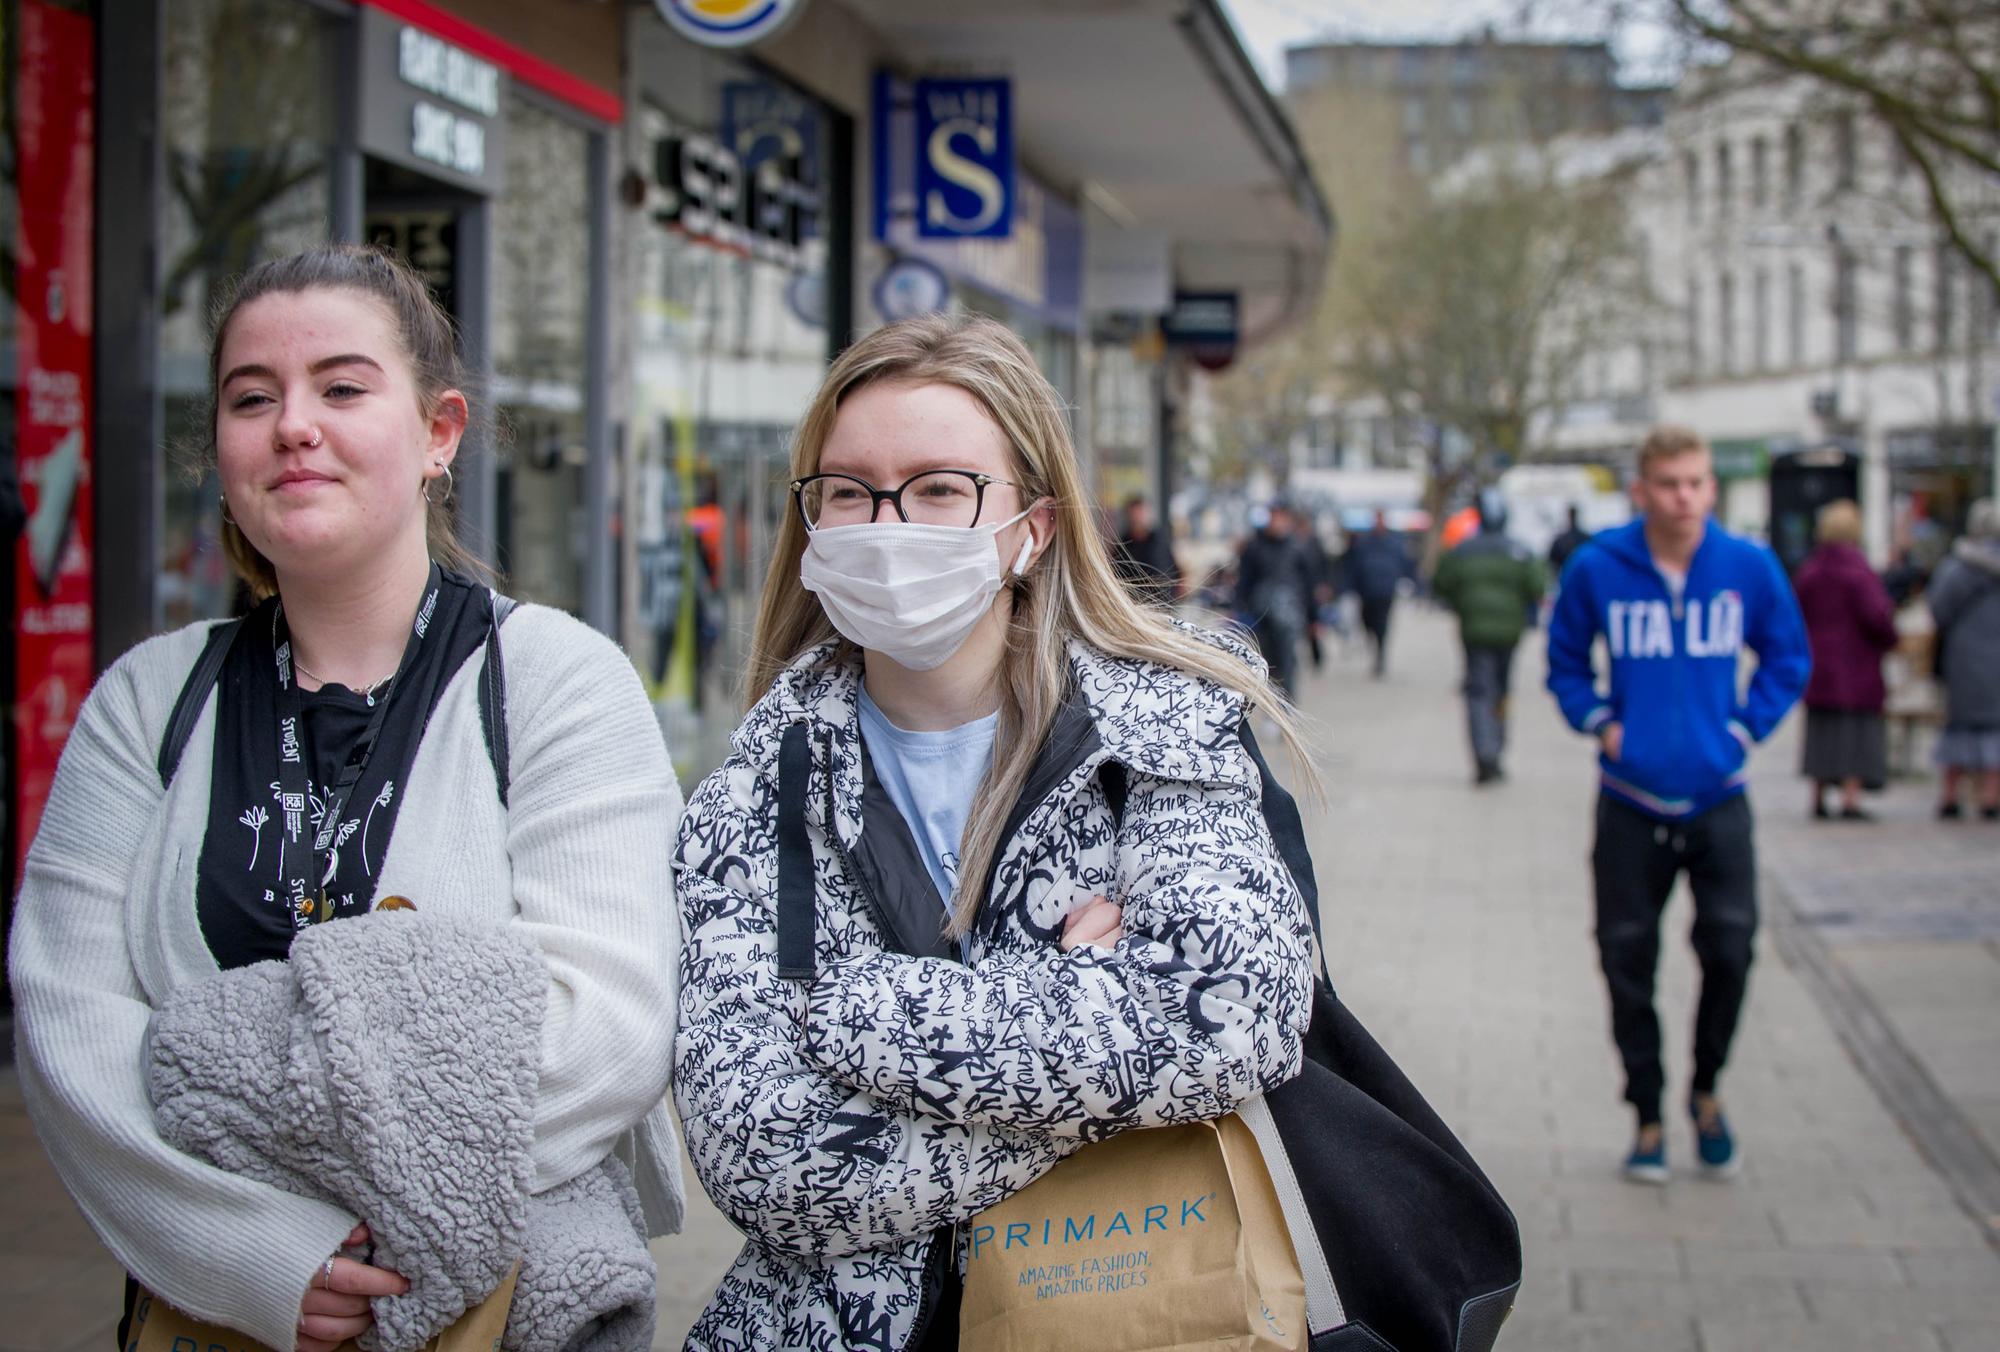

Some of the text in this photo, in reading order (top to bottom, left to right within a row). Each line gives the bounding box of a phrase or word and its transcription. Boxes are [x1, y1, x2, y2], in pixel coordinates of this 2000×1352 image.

[926, 117, 1006, 234] S
[282, 717, 300, 763] STUDENT
[973, 1196, 1207, 1260] PRIMARK
[1018, 1250, 1153, 1287] AMAZING FASHION,
[1036, 1270, 1147, 1300] AMAZING PRICES
